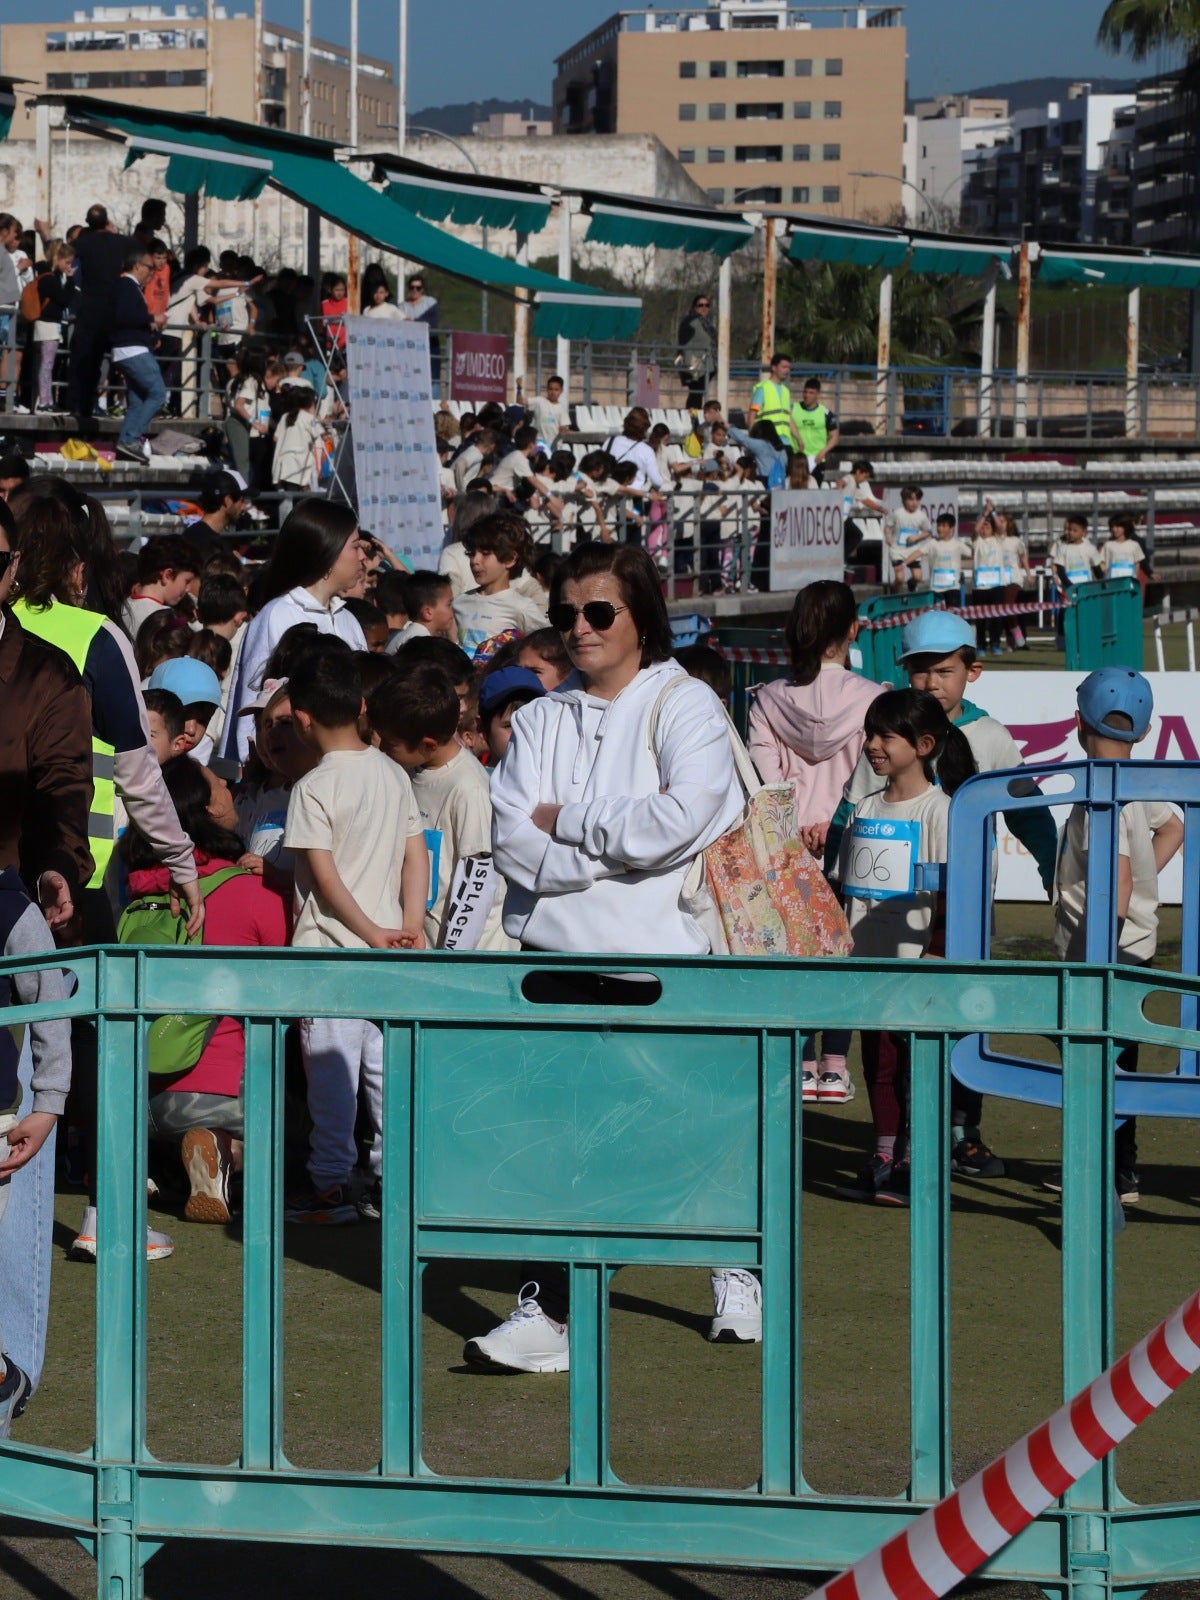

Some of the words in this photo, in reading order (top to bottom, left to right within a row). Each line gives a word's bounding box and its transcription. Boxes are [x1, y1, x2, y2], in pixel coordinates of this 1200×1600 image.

[466, 352, 505, 380] IMDECO
[789, 506, 842, 546] IMDECO
[852, 822, 880, 834] nicef
[849, 844, 891, 881] 106
